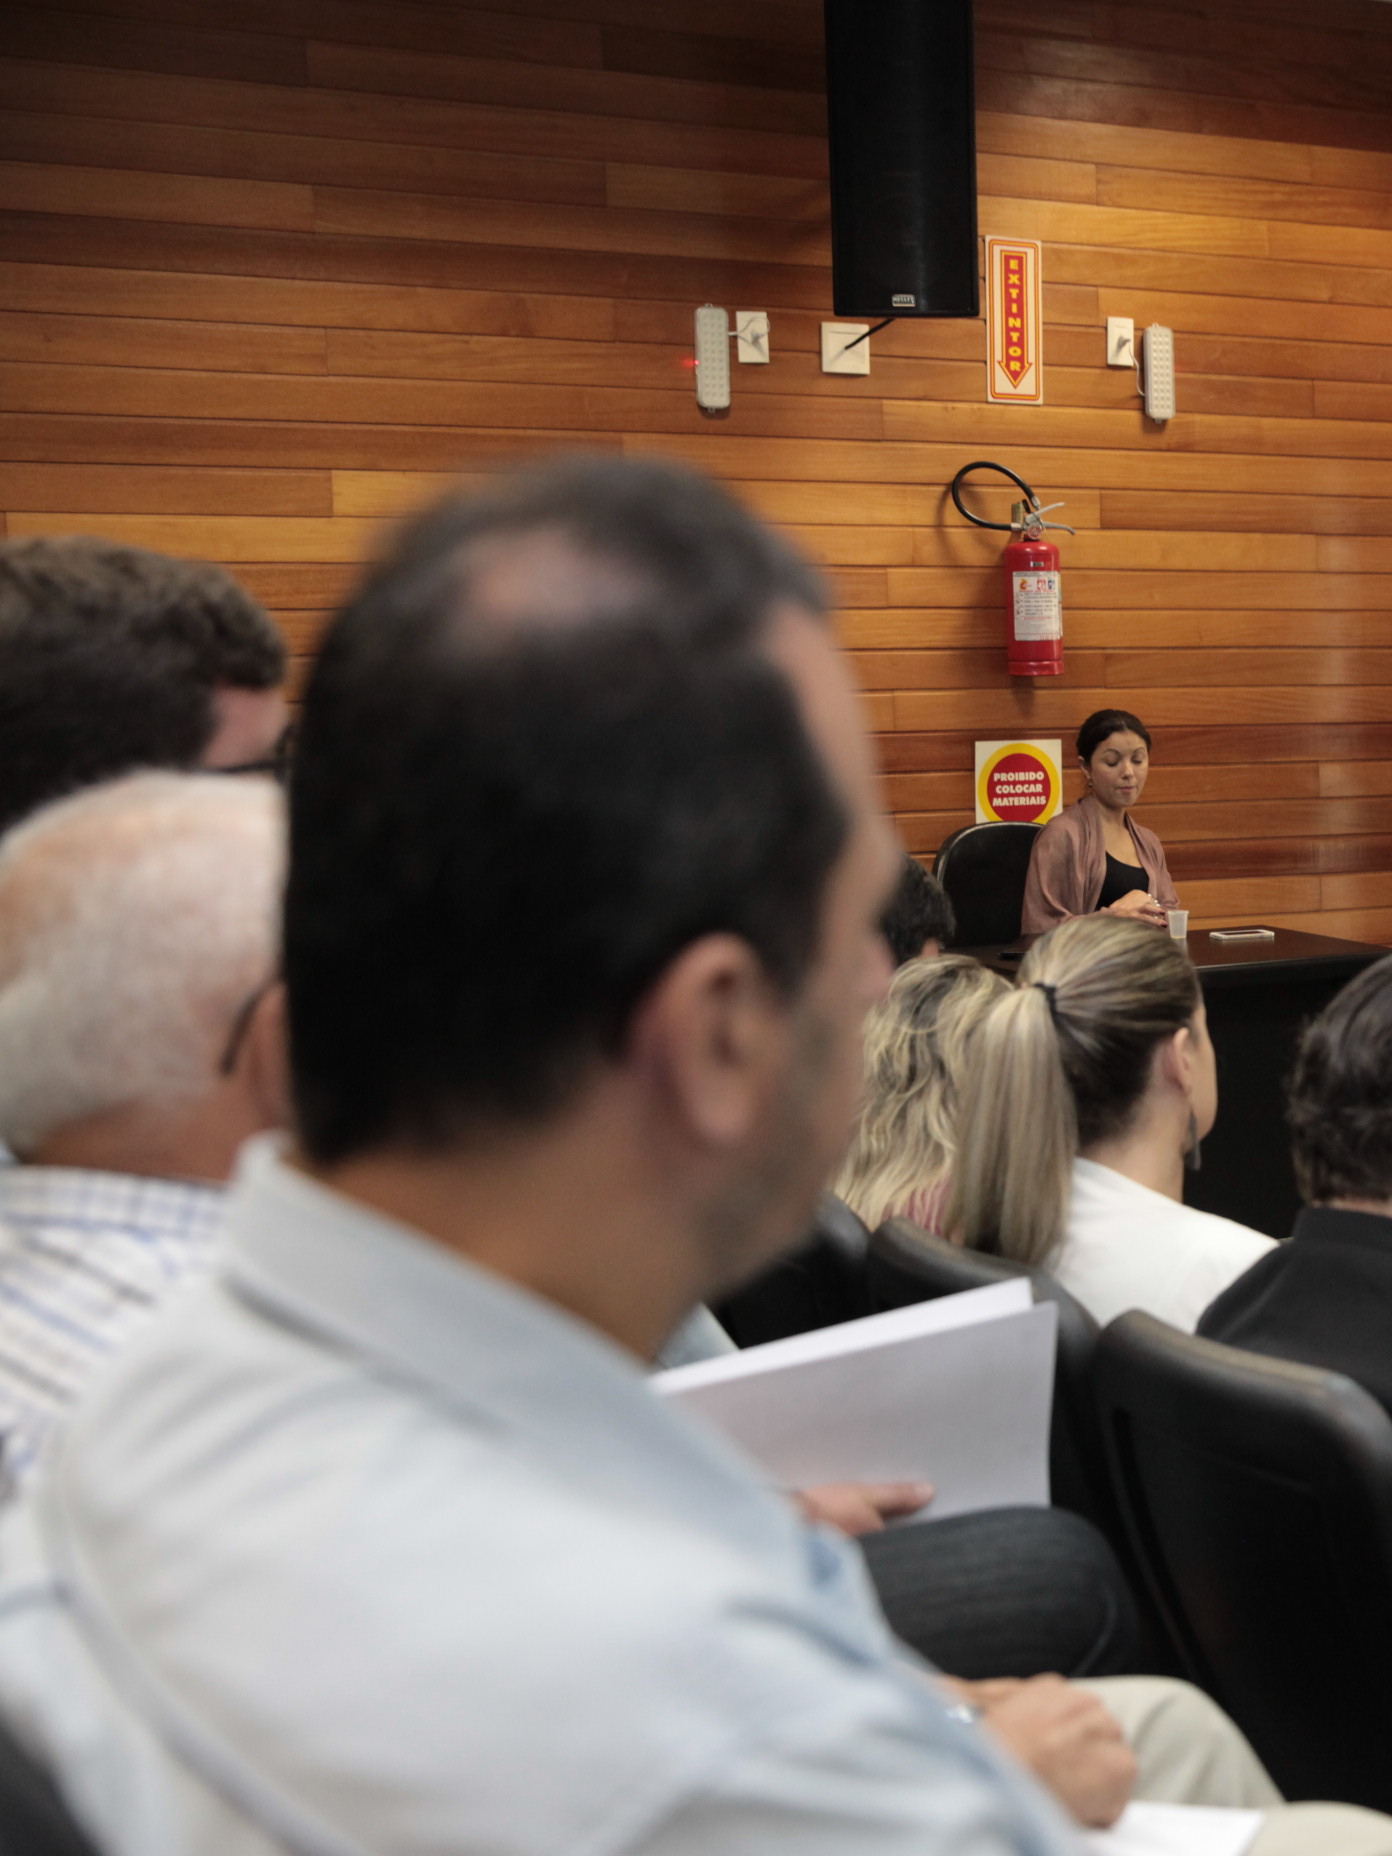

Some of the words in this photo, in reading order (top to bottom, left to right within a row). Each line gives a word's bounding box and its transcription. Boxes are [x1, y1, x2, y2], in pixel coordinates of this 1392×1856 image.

[1008, 259, 1022, 372] EXTINTOR
[993, 771, 1045, 782] PROIBIDO
[995, 784, 1043, 794] COLOCAR
[992, 796, 1047, 807] MATERIAIS
